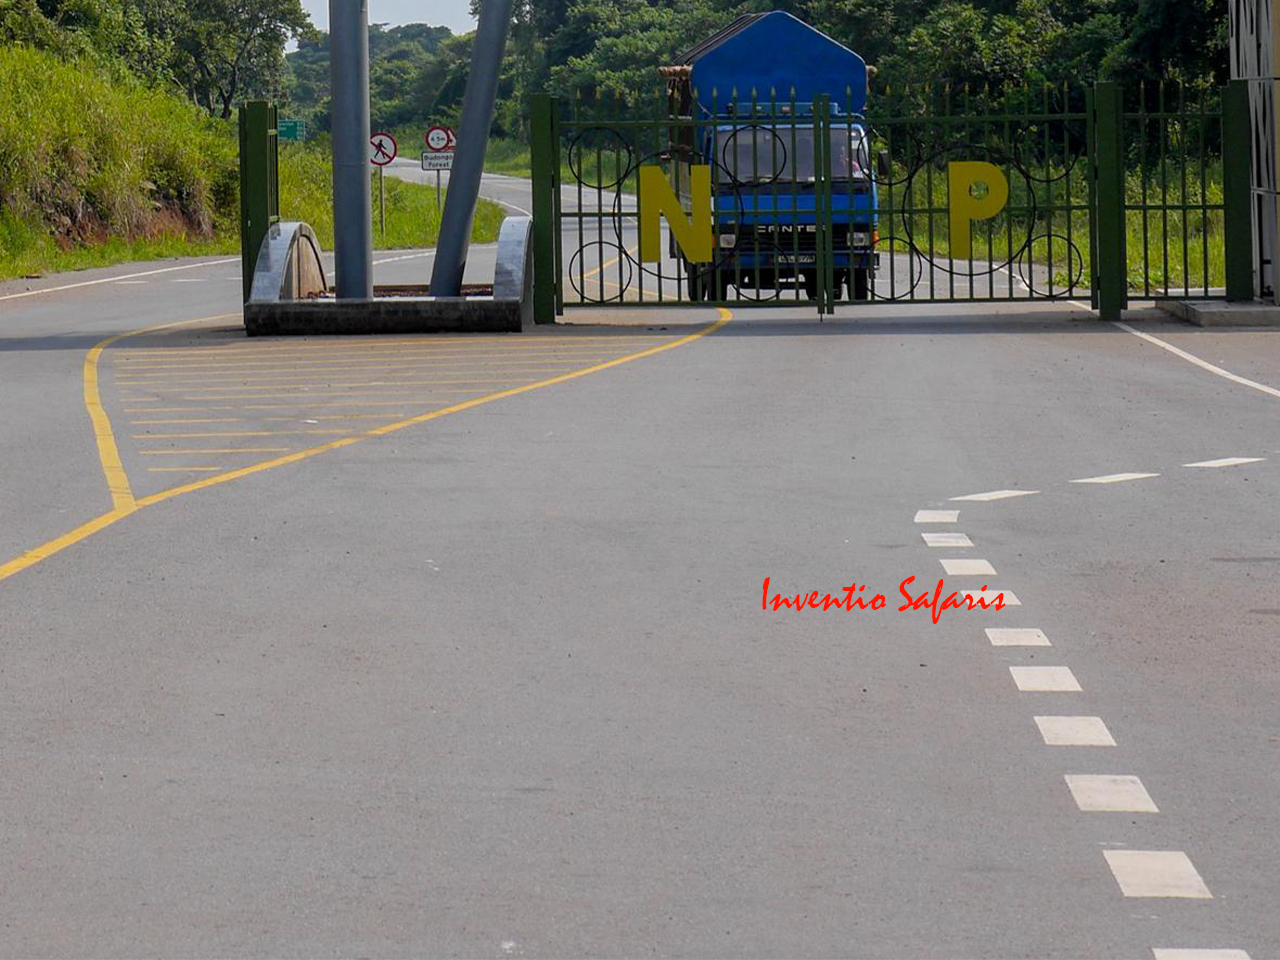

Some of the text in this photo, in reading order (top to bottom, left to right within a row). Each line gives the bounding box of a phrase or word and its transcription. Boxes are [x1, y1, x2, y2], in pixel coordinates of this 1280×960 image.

[423, 154, 453, 162] Budongo
[639, 161, 1009, 263] N P
[757, 224, 826, 233] CANTE
